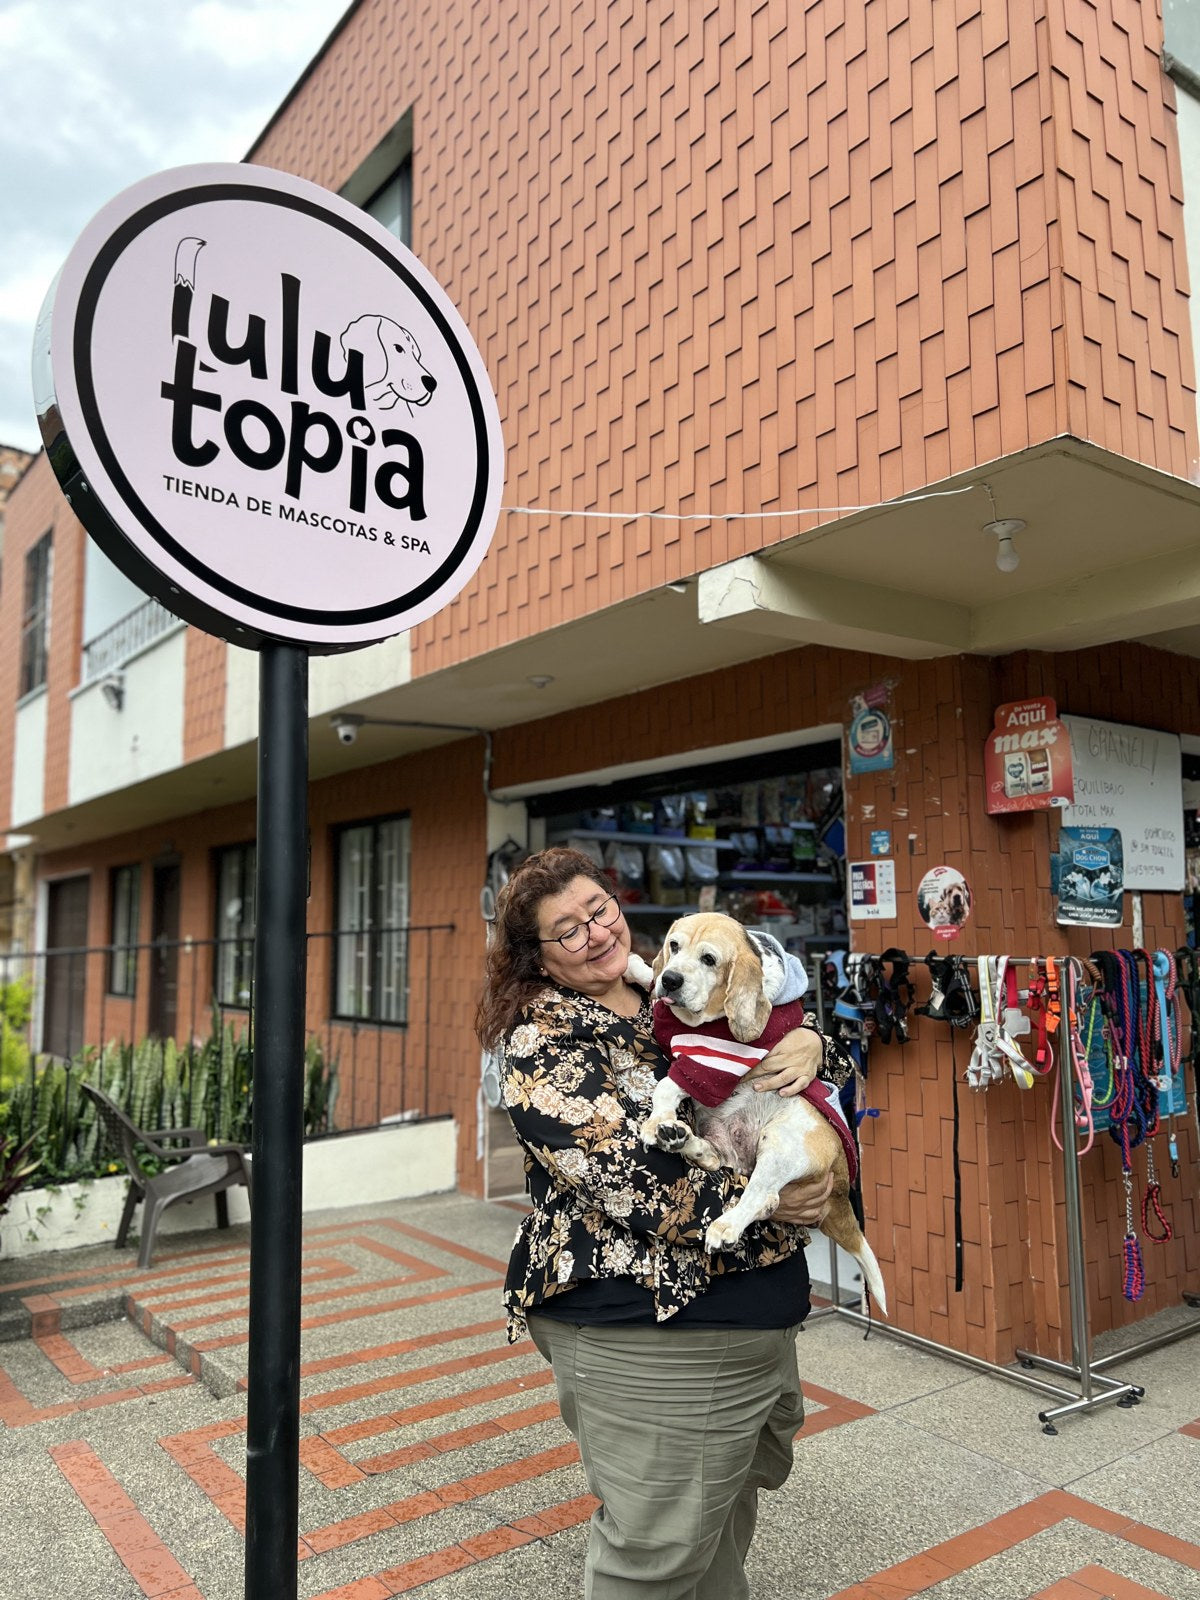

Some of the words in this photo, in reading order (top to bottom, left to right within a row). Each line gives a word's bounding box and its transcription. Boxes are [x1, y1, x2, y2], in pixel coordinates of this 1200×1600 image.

[171, 254, 367, 410] lulu
[160, 338, 428, 521] topia
[162, 475, 240, 508] TIENDA
[246, 496, 272, 516] DE
[279, 504, 378, 542] MASCOTAS
[383, 531, 396, 546] &
[401, 535, 431, 555] SPA
[994, 726, 1058, 754] max
[1006, 705, 1047, 727] Aquí
[1072, 804, 1096, 817] TOTAL
[1100, 805, 1115, 816] MAX
